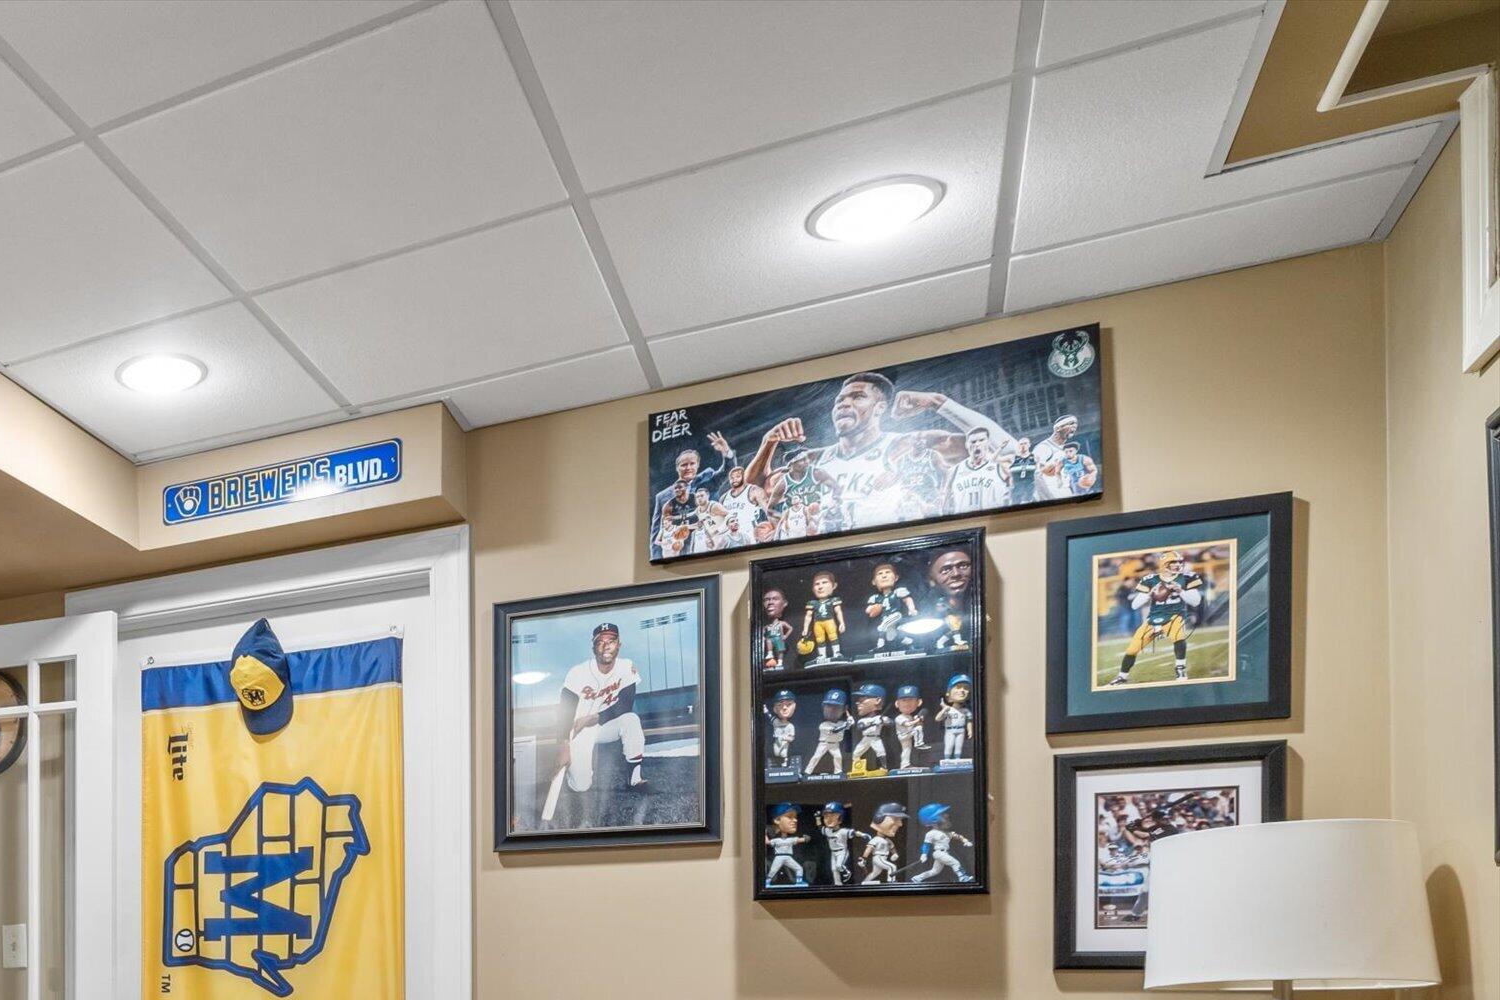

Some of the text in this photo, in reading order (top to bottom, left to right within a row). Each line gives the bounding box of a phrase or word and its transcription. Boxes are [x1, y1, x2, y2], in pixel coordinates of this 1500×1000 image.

[651, 422, 693, 443] DEER
[656, 409, 688, 427] FEAR
[208, 457, 388, 513] BREWERS BLVD.
[167, 732, 189, 782] Lite
[204, 845, 315, 942] M
